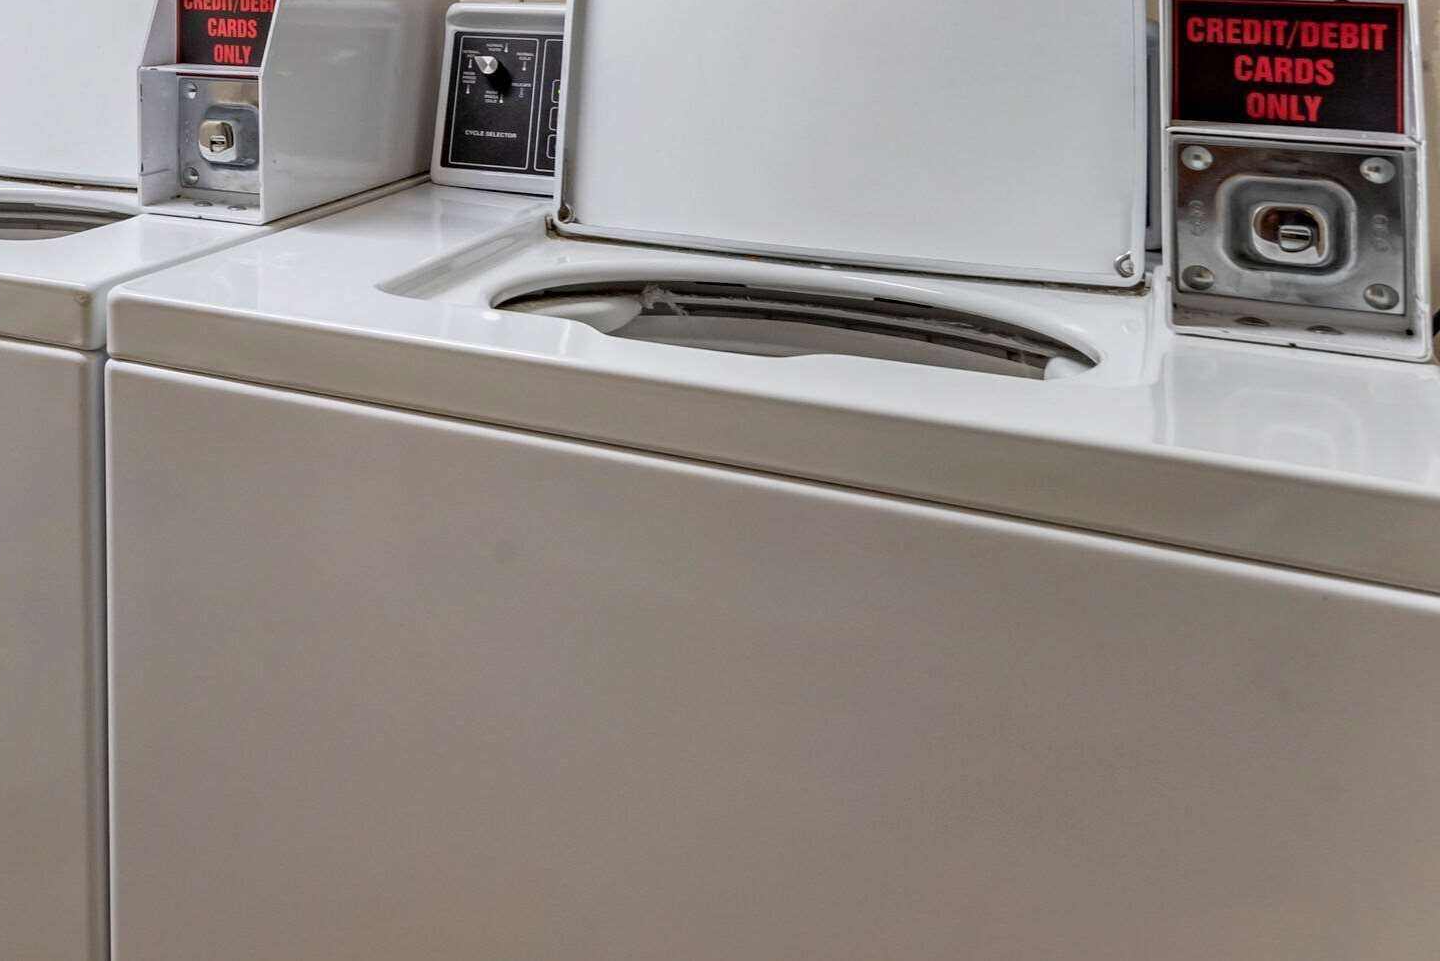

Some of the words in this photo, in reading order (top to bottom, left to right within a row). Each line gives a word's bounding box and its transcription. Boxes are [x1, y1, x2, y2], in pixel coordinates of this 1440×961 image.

[207, 17, 258, 38] CARDS
[1186, 16, 1389, 52] CREDIT/DEBIT
[213, 44, 253, 65] ONLY
[1233, 54, 1336, 86] CARDS
[1246, 91, 1324, 123] ONLY
[464, 129, 485, 137] CYCLE
[485, 130, 518, 139] SELECTOR
